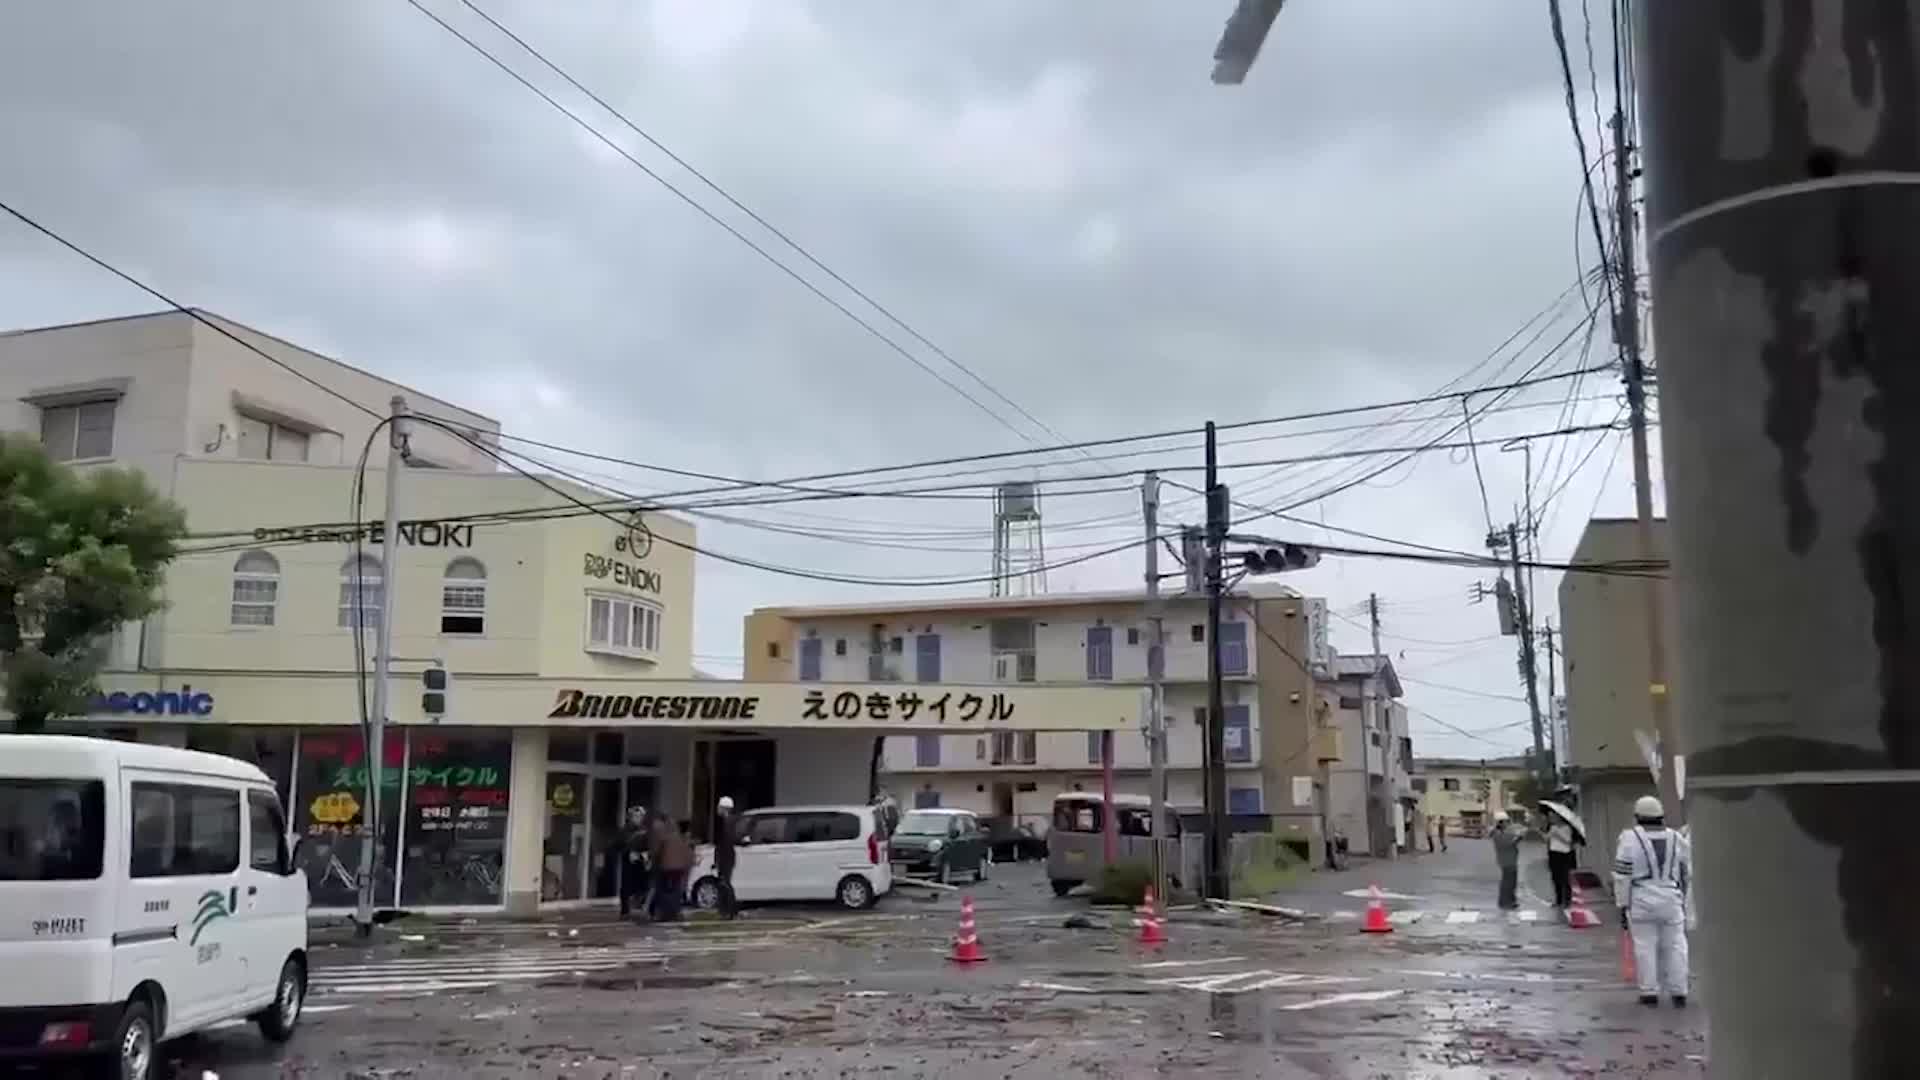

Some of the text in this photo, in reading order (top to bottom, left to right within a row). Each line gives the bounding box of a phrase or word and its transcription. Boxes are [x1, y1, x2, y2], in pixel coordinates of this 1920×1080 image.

[369, 521, 474, 547] ENOKI
[614, 560, 661, 594] ENOKI
[548, 689, 759, 719] BRIDGESTONE
[802, 690, 1015, 723] えのきサイクル
